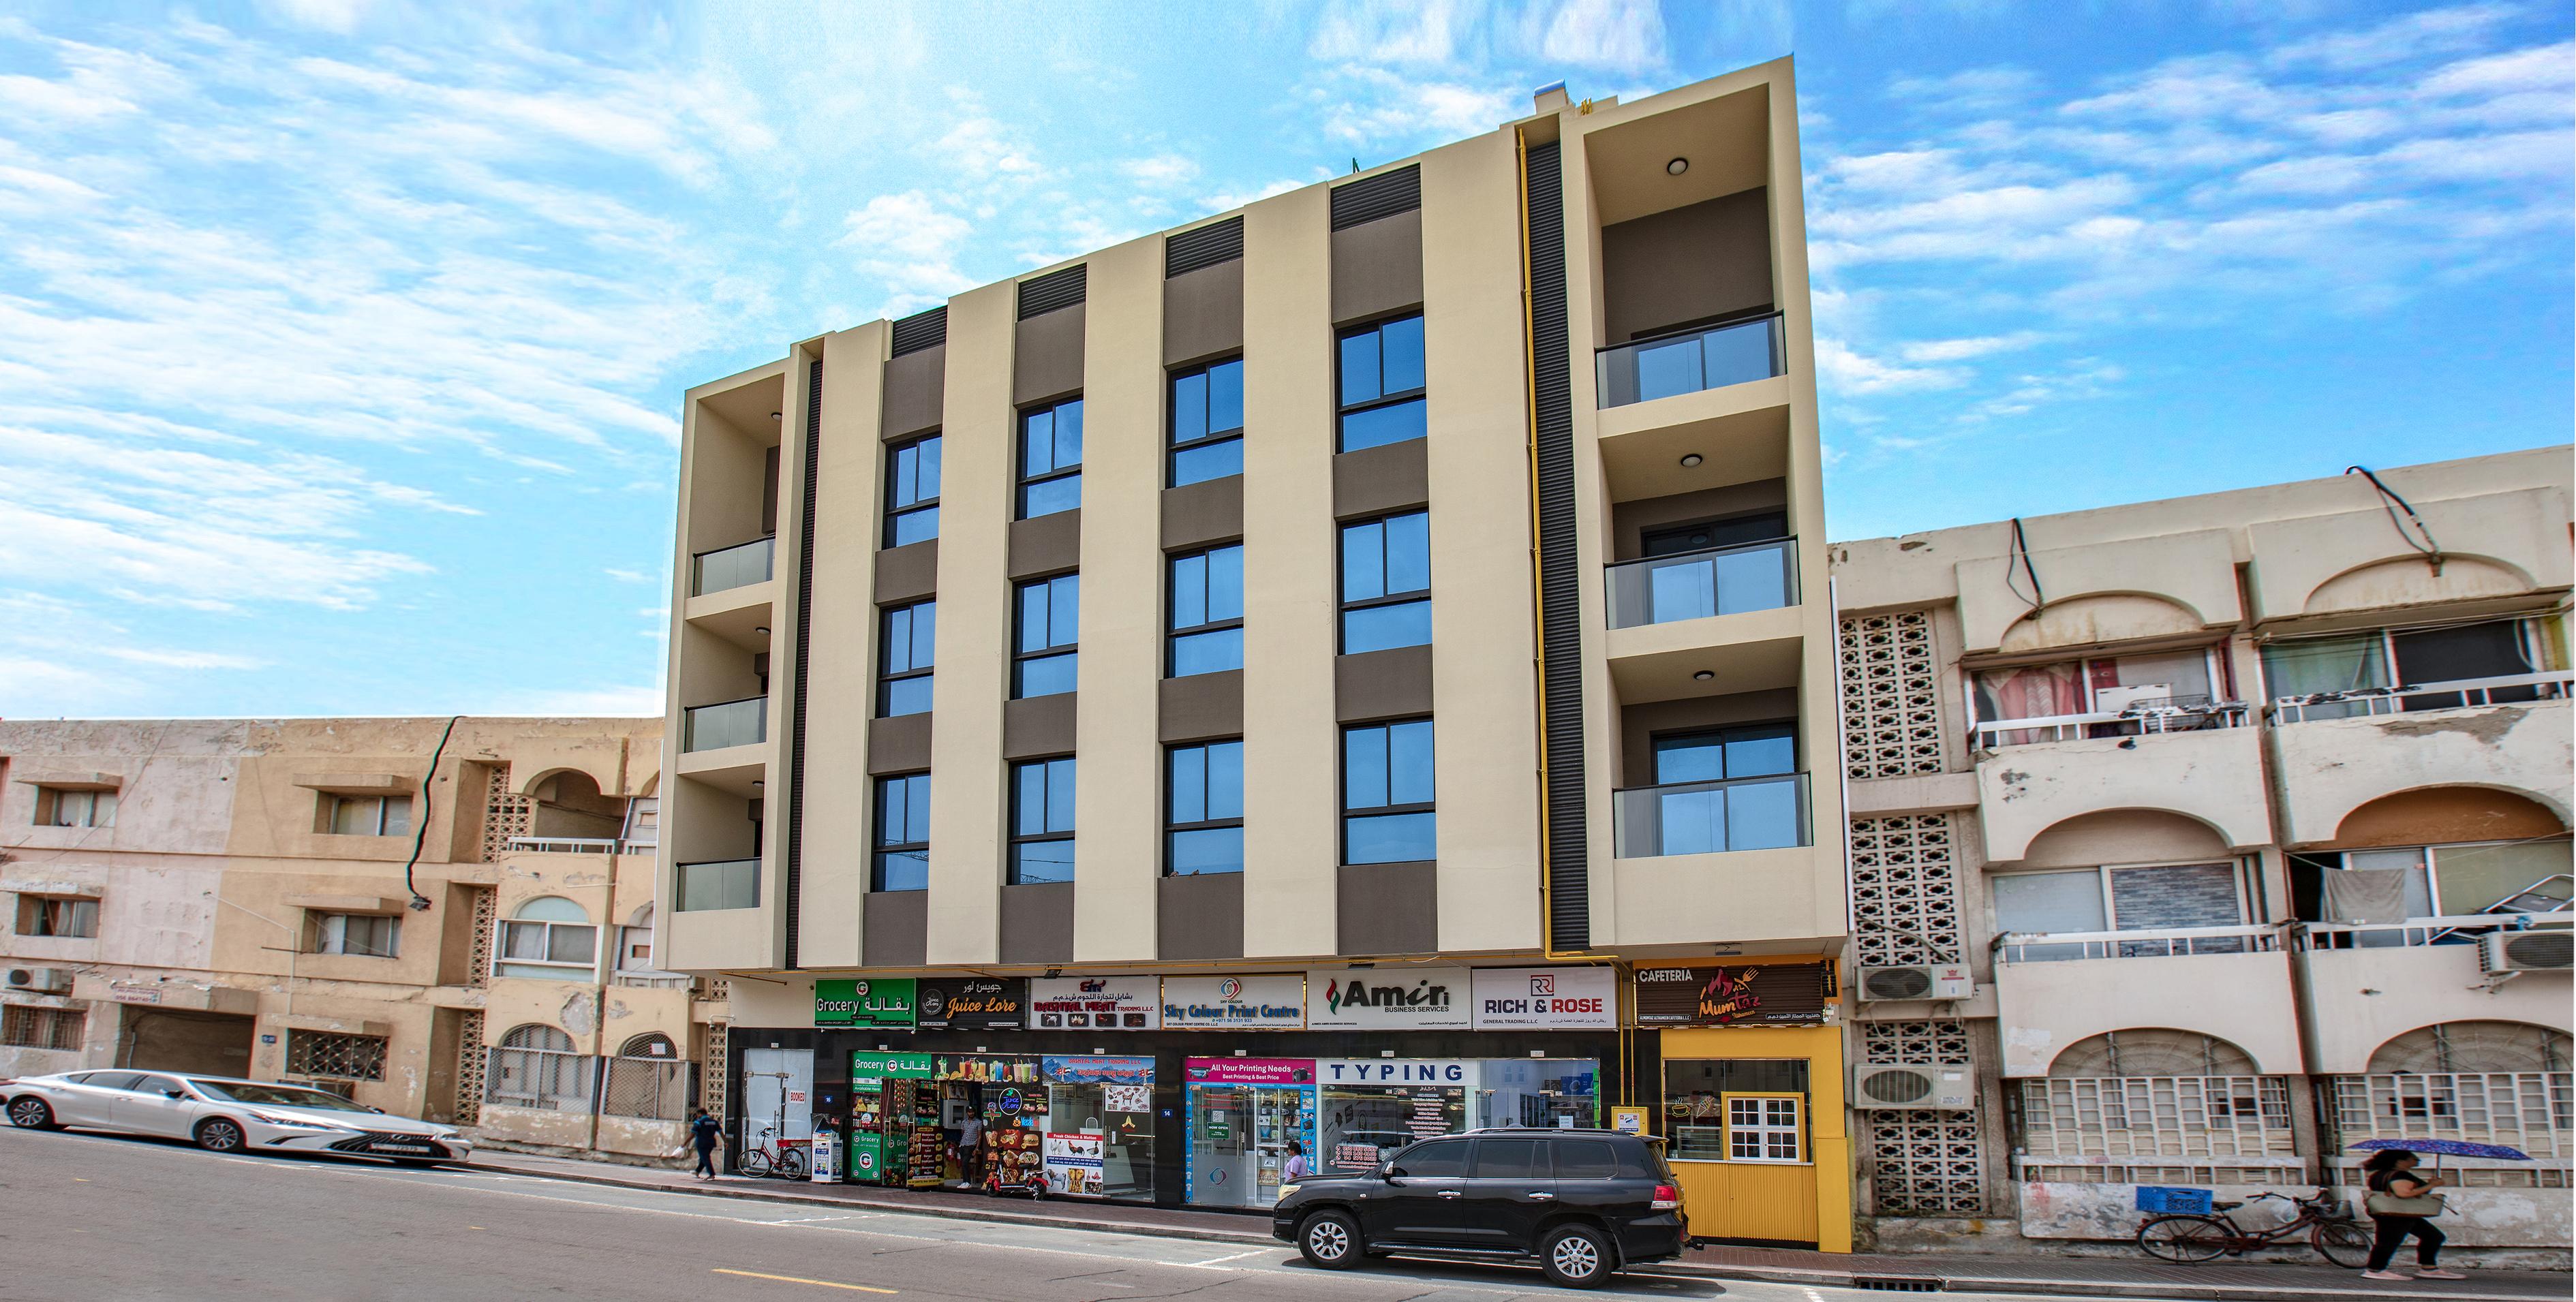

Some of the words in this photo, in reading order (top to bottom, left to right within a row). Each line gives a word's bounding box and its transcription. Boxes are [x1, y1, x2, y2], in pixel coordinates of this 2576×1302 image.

[1639, 970, 1693, 982] CAFETERIA
[963, 981, 975, 993] لور
[977, 983, 1002, 993] جويس
[1342, 980, 1449, 1006] Amiri
[1077, 993, 1097, 1002] اللحوم
[1115, 993, 1133, 1001] بشايل
[817, 998, 859, 1014] Grocery
[865, 997, 910, 1014] بقالة
[946, 997, 982, 1019] Juice
[985, 997, 1017, 1012] Lore
[1034, 1002, 1084, 1012] BASHYAL
[1085, 1002, 1117, 1012] MEAT
[1485, 999, 1527, 1013] RICH
[1535, 999, 1547, 1013] &
[1552, 998, 1602, 1012] ROSE
[1698, 992, 1761, 1018] Mumtaz
[1165, 1004, 1186, 1021] Sky
[1189, 1004, 1225, 1018] Colour
[1228, 1005, 1259, 1018] Print
[1261, 1004, 1300, 1018] Centre
[855, 1059, 885, 1071] Grocery
[900, 1060, 930, 1073] بقالة
[1239, 1064, 1267, 1073] Printing
[1331, 1064, 1462, 1081] TYPING
[791, 1091, 805, 1101] BOOKED
